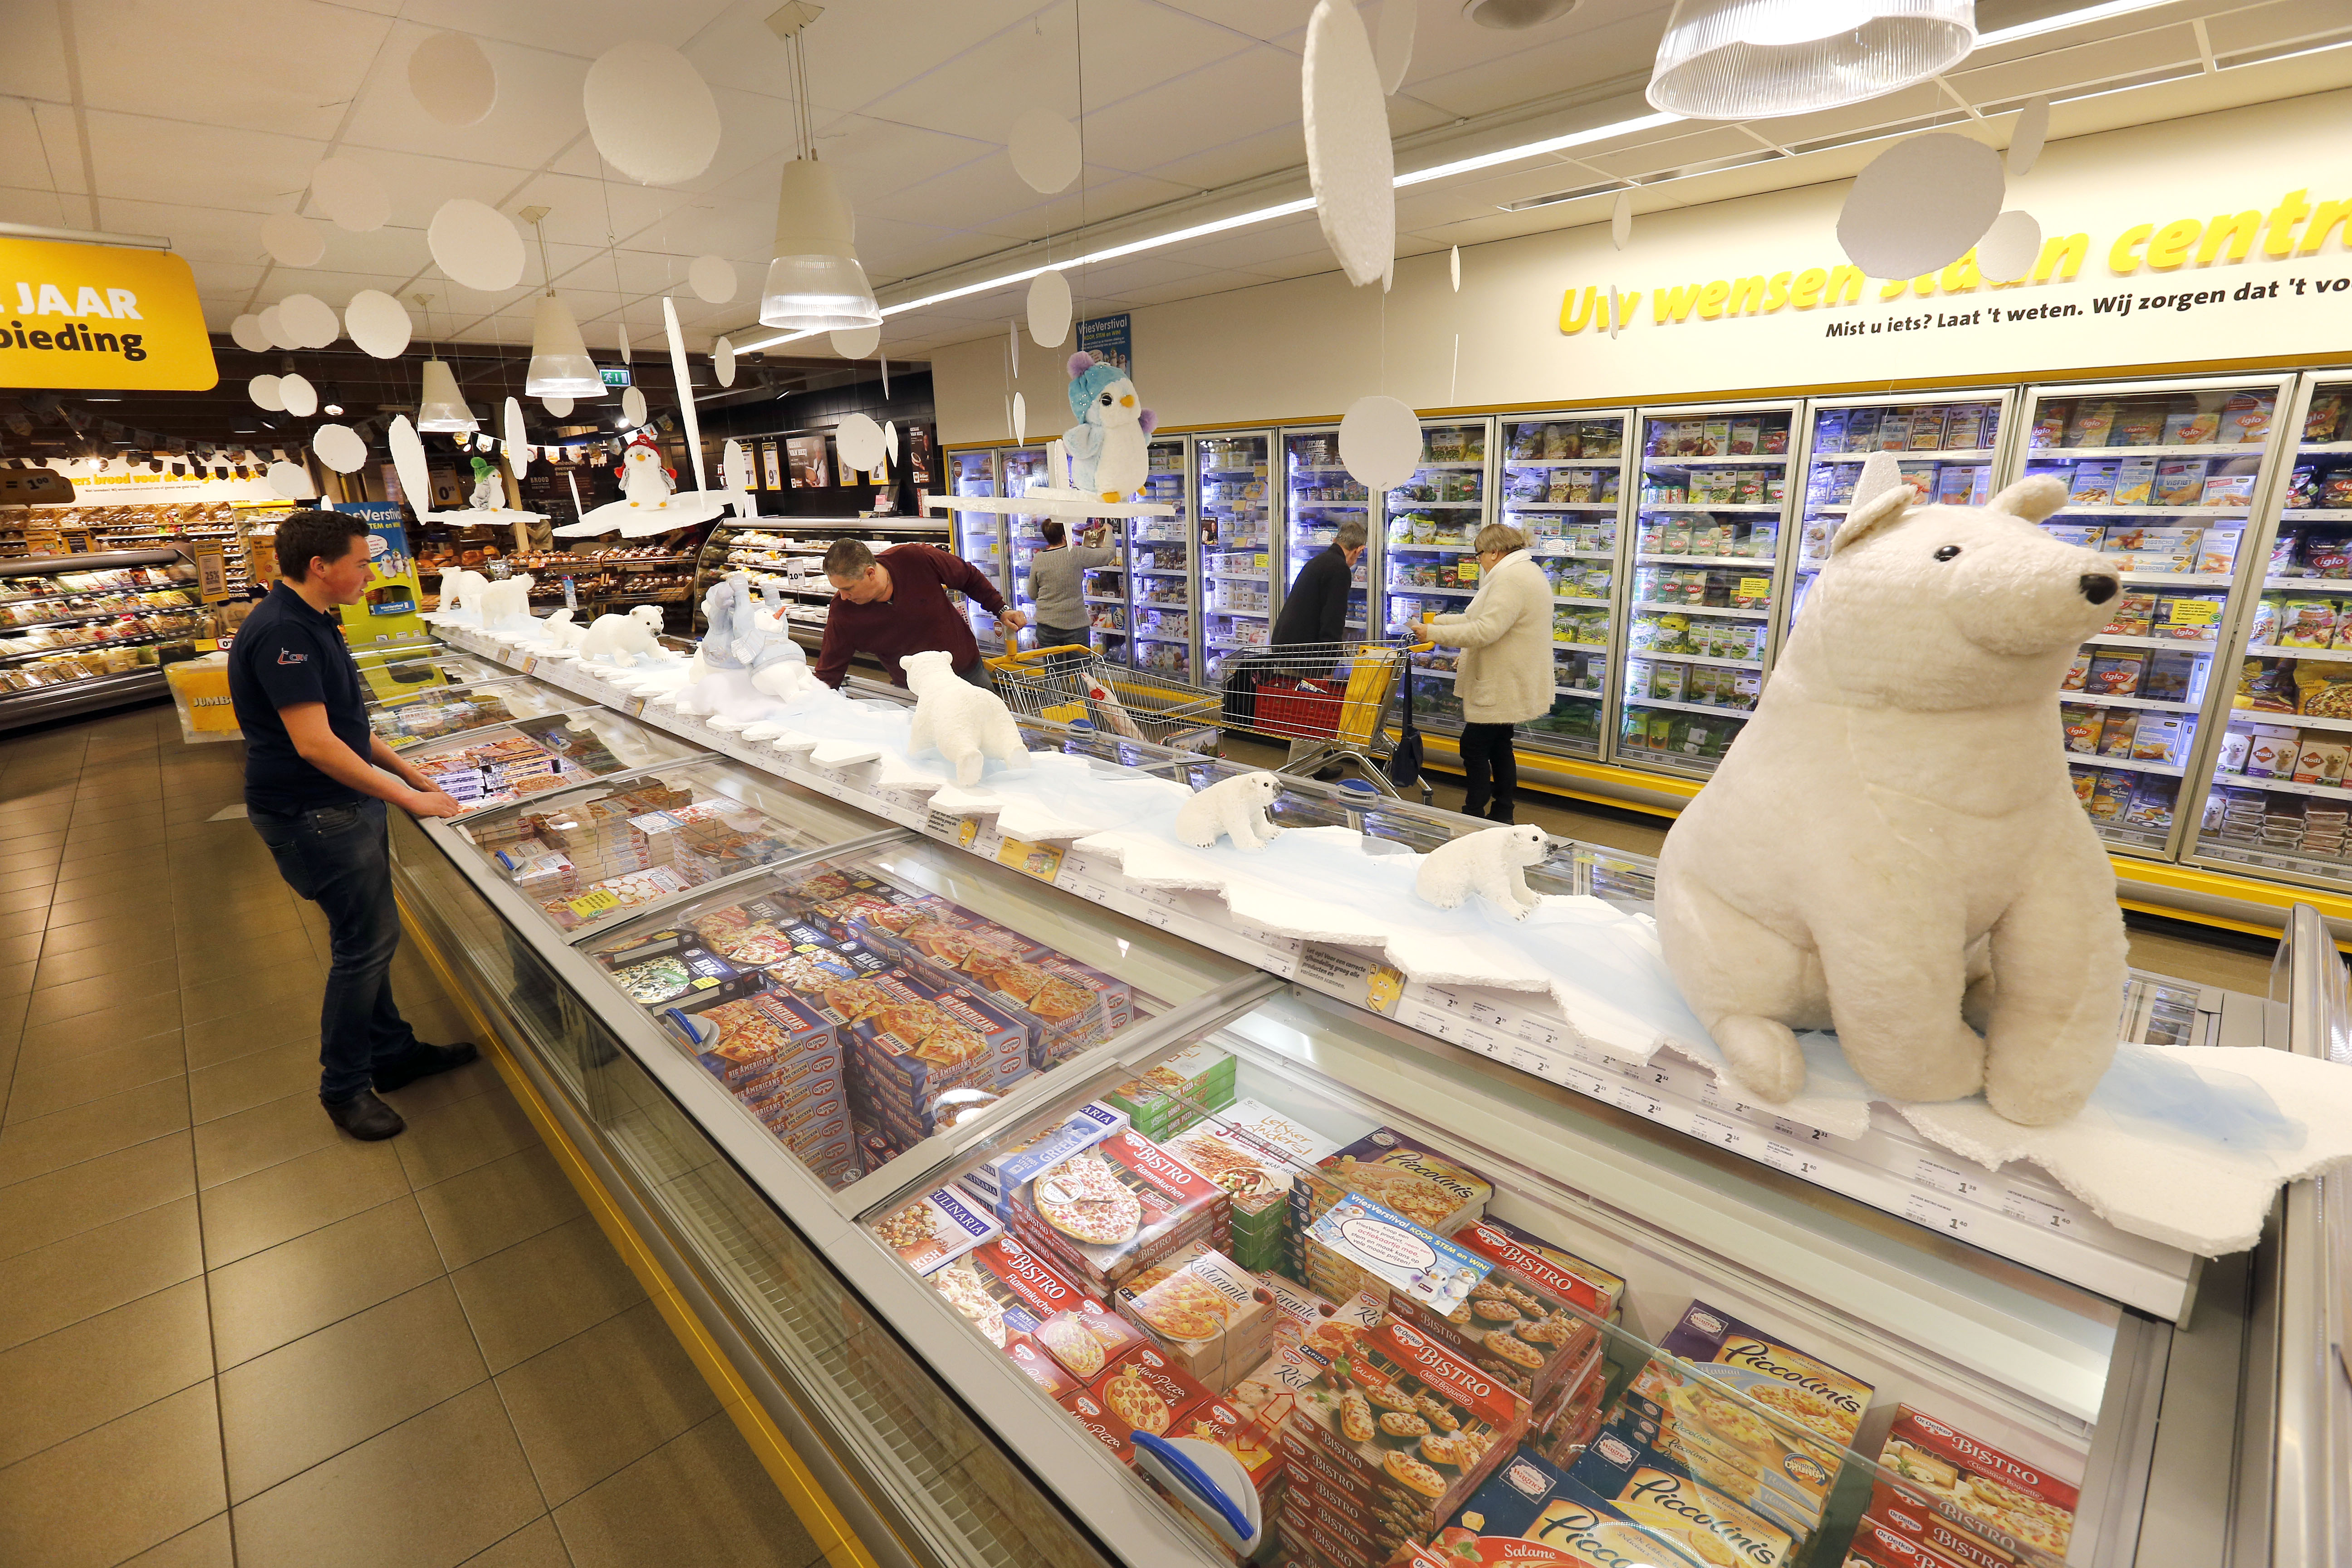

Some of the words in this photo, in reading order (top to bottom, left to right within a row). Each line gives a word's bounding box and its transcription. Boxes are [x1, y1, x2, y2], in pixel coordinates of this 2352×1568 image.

[1559, 285, 1641, 332] Uw
[1654, 265, 1866, 321] wensen
[2108, 187, 2352, 272] centr
[16, 282, 144, 319] JAAR
[1826, 320, 1865, 337] Mist
[1871, 322, 1882, 333] u
[1887, 314, 1931, 332] iets?
[1937, 310, 1980, 328] Laat
[2007, 304, 2083, 321] weten.
[2093, 294, 2132, 316] Wij
[2138, 289, 2225, 311] zorgen
[2234, 281, 2279, 300] dat
[2315, 278, 2352, 293] vo
[2035, 427, 2051, 436] iglo
[2084, 419, 2101, 429] iglo
[2181, 428, 2199, 438] iglo
[2241, 415, 2261, 425] iglo
[93, 472, 131, 485] brood
[132, 474, 163, 484] voor
[2319, 557, 2344, 567] iglo
[2105, 671, 2123, 682] iglo
[2070, 727, 2087, 735] iglo
[857, 952, 886, 970] BIG
[1301, 962, 1327, 975] producten
[1323, 952, 1336, 961] Voor
[1058, 964, 1104, 990] AMERICANS
[766, 1001, 808, 1031] AMERICANS
[952, 1001, 1000, 1033] AMERICANS
[883, 1033, 910, 1052] SUPREME
[739, 1055, 775, 1073] AMERICANS
[939, 1058, 972, 1076] AMERICANS
[745, 1077, 780, 1095] AMERICANS
[1181, 1111, 1193, 1123] PIZZA
[1021, 1155, 1039, 1167] GYROS
[1039, 1134, 1078, 1163] GREEK
[1016, 1160, 1034, 1170] STYLE
[1133, 1145, 1192, 1186] BISTRO
[1382, 1149, 1474, 1199] Piccolinis
[1133, 1163, 1186, 1200] Flammkuchen
[1024, 1209, 1049, 1235] BISTRO
[1049, 1229, 1080, 1259] Flammkuchen
[1138, 1235, 1172, 1262] BISTRO
[1173, 1206, 1211, 1235] Flammkuchen
[1351, 1193, 1410, 1229] VriesVerstival
[1409, 1225, 1434, 1243] KOOP,
[1434, 1240, 1456, 1254] STEM
[1456, 1251, 1468, 1260] en
[1469, 1257, 1490, 1272] WIN!
[1357, 1227, 1401, 1250] actiekaartje
[1401, 1246, 1420, 1258] mee,
[1381, 1230, 1403, 1245] product,
[1404, 1241, 1420, 1250] neem
[1383, 1225, 1397, 1236] Koop
[1026, 1233, 1050, 1259] BISTRO
[1144, 1245, 1176, 1270] BISTRO
[1351, 1232, 1365, 1241] stem
[1375, 1241, 1394, 1254] maak
[1394, 1249, 1410, 1259] kans
[1353, 1238, 1366, 1247] vele
[1366, 1244, 1386, 1255] mooie
[1387, 1252, 1411, 1266] prijzen!
[1007, 1252, 1066, 1299] BISTRO
[1183, 1254, 1251, 1303] Ristorante
[1499, 1245, 1573, 1291] BISTRO
[1005, 1273, 1057, 1317] Flammkuchen
[1073, 1309, 1095, 1329] Mini
[1095, 1322, 1122, 1341] Pizza
[1421, 1313, 1461, 1346] BISTRO
[1026, 1368, 1052, 1390] Pizza
[1131, 1363, 1152, 1382] Mini
[1153, 1376, 1186, 1397] Pizza
[1352, 1364, 1382, 1386] SALAMI
[1414, 1346, 1491, 1397] BISTRO
[1724, 1333, 1861, 1414] Piccolinis
[1423, 1371, 1440, 1384] Mini
[1439, 1382, 1470, 1403] Baguette
[1091, 1423, 1121, 1448] Pizza
[1321, 1430, 1362, 1469] BISTRO
[1312, 1454, 1354, 1491] BISTRO
[1951, 1436, 2039, 1486] BISTRO
[1513, 1466, 1546, 1493] Wagner
[1970, 1461, 2005, 1484] Classique
[2005, 1477, 2041, 1499] Baguette
[1316, 1481, 1358, 1519] BISTRO
[1317, 1505, 1359, 1546] BISTRO
[1631, 1465, 1775, 1566] Piccolinis
[1312, 1528, 1352, 1567] BISTRO
[1504, 1544, 1557, 1560] Salame
